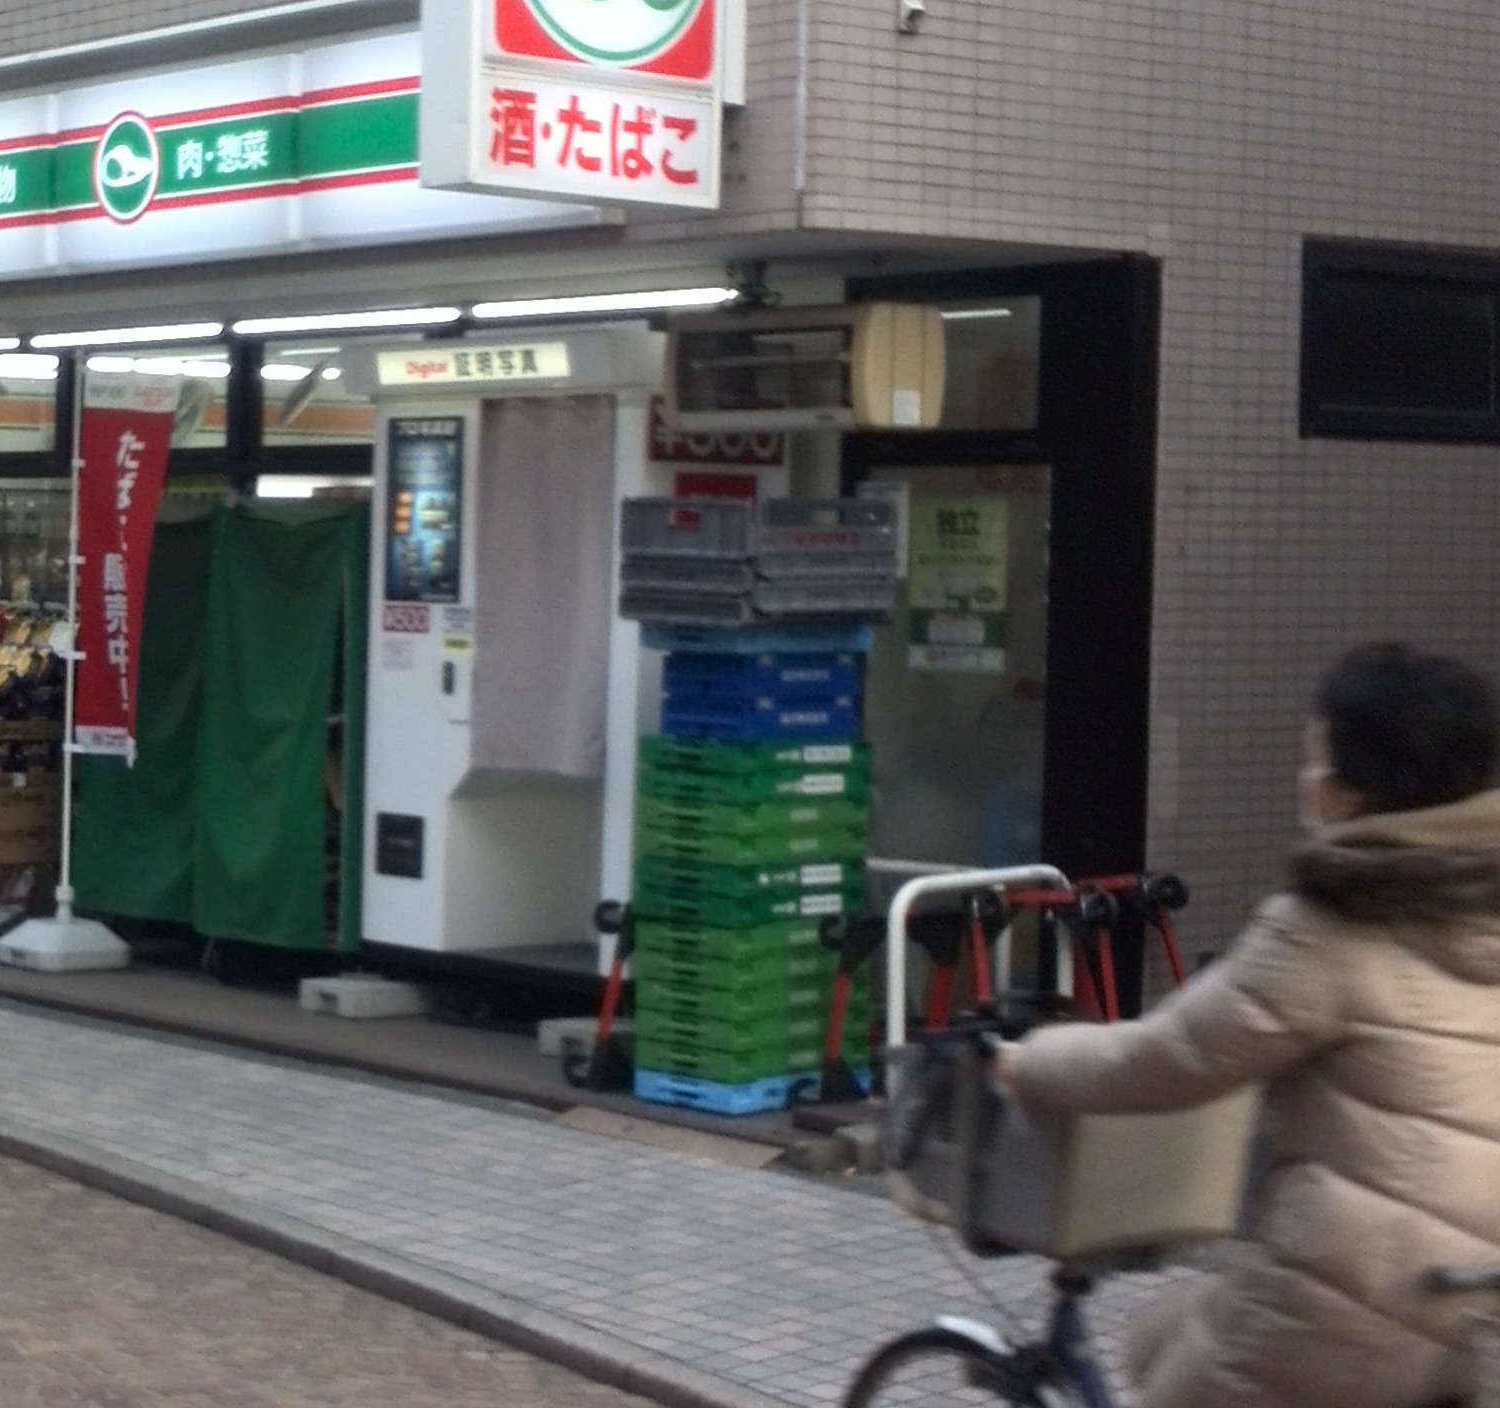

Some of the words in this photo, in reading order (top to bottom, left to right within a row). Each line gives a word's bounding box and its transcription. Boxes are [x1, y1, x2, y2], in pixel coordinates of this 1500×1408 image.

[488, 86, 700, 186] 酒・たばこ
